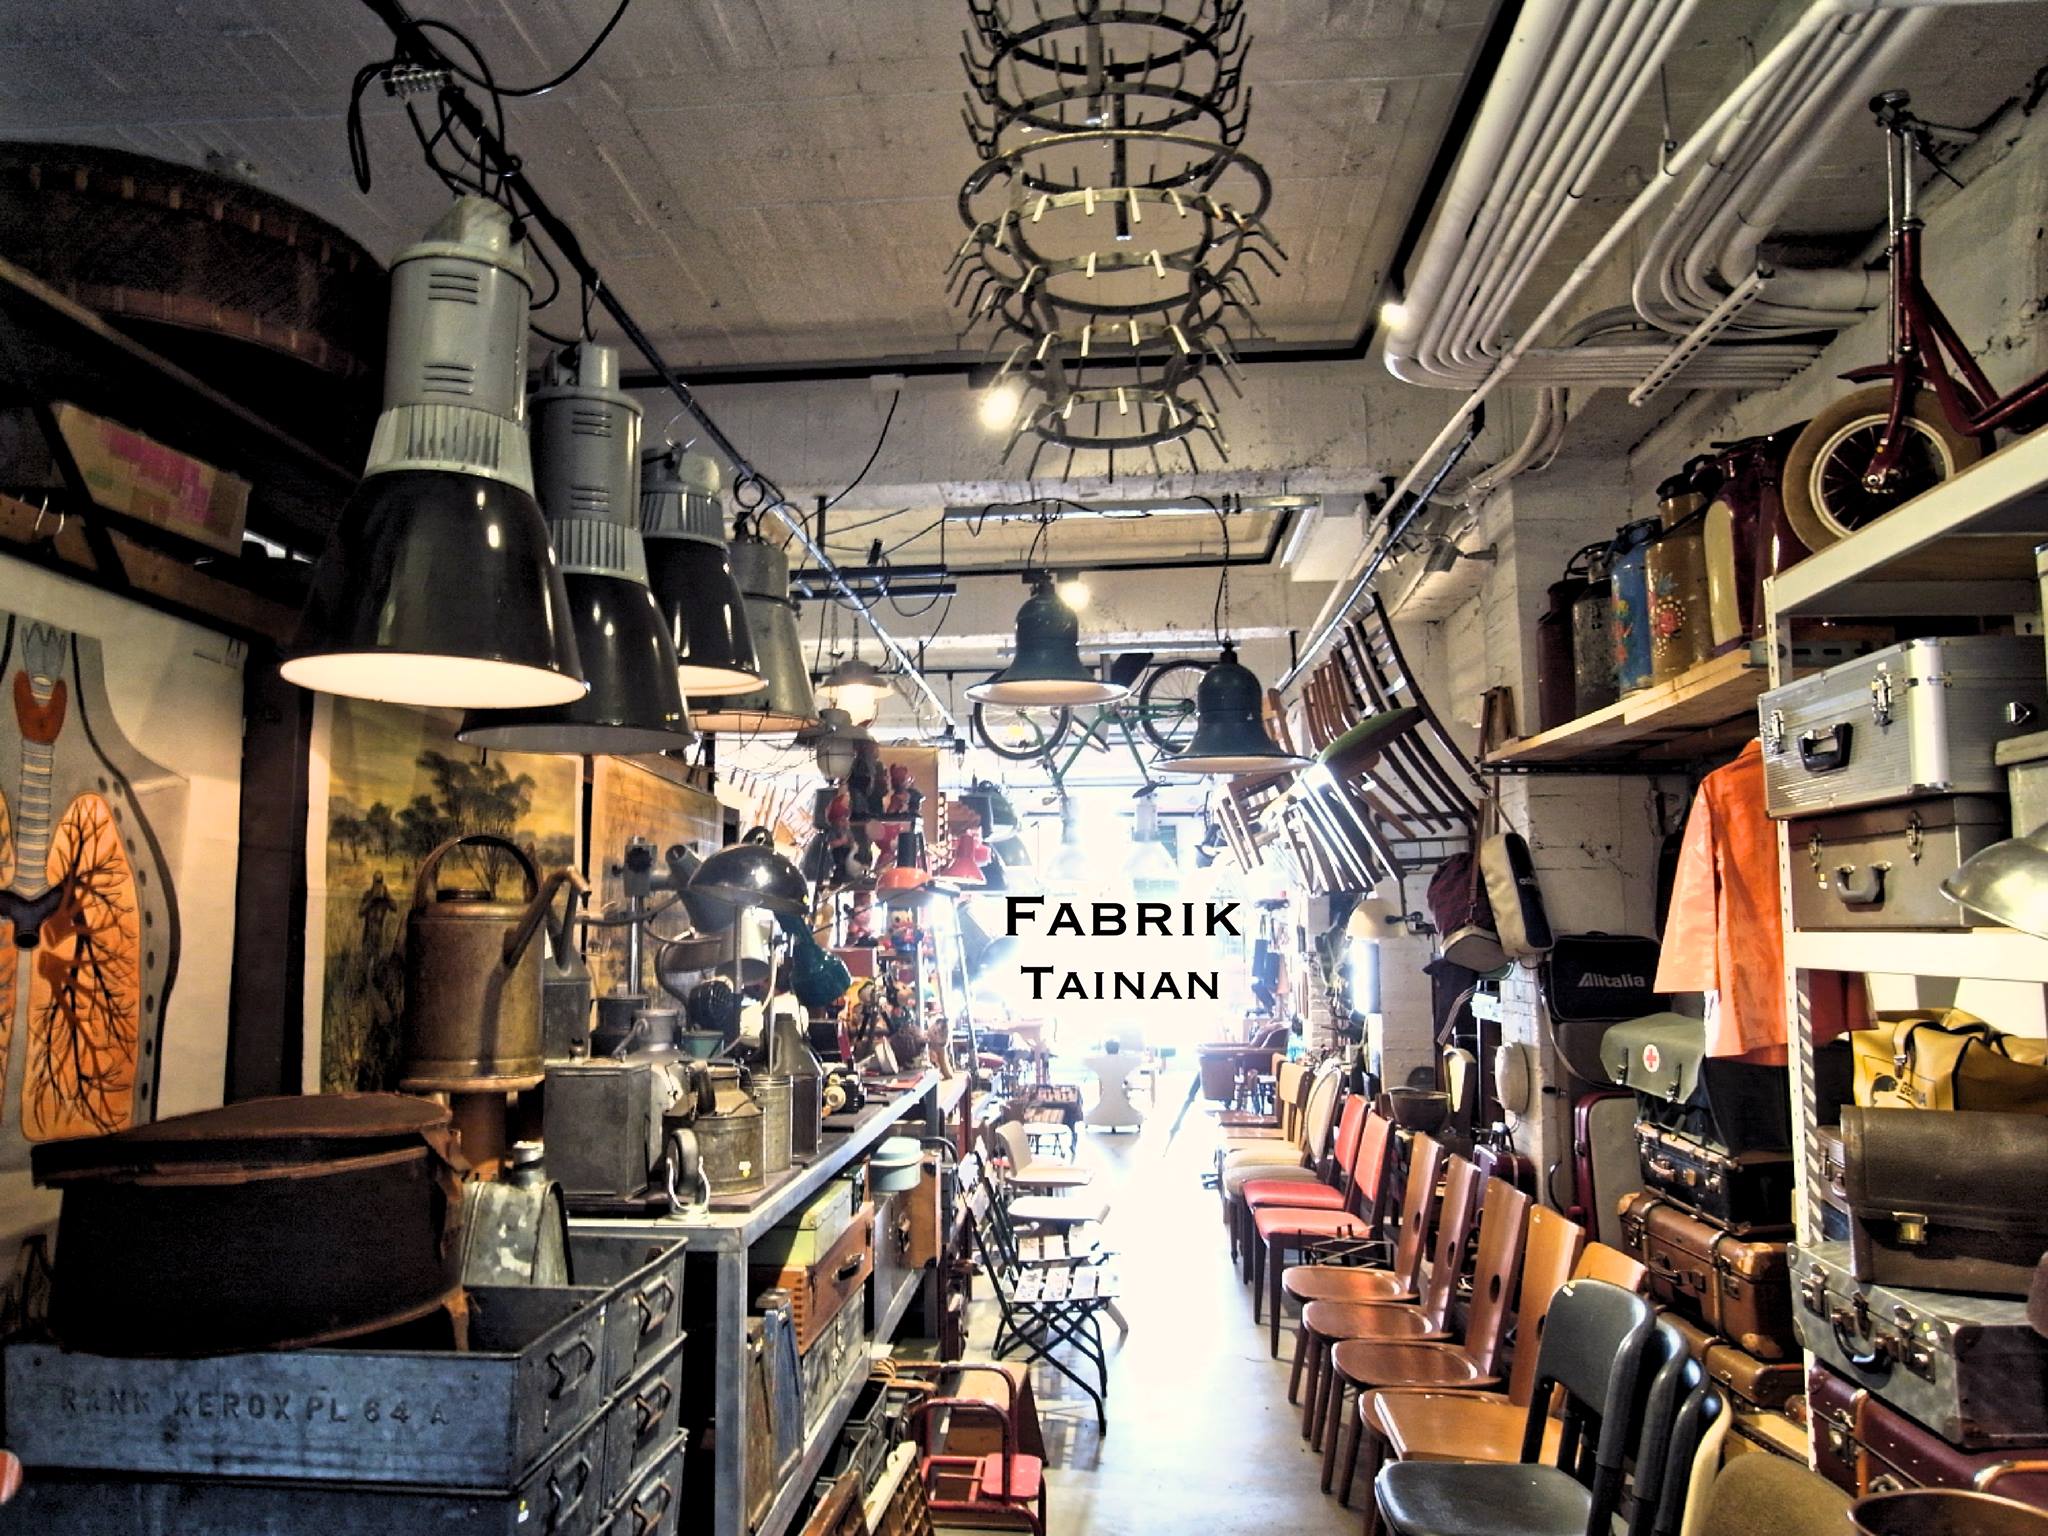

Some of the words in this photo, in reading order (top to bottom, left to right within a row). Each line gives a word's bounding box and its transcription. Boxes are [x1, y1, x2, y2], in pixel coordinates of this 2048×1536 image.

[1578, 972, 1646, 988] Alitalia
[173, 1389, 291, 1422] XEROX
[306, 1396, 347, 1424] PL
